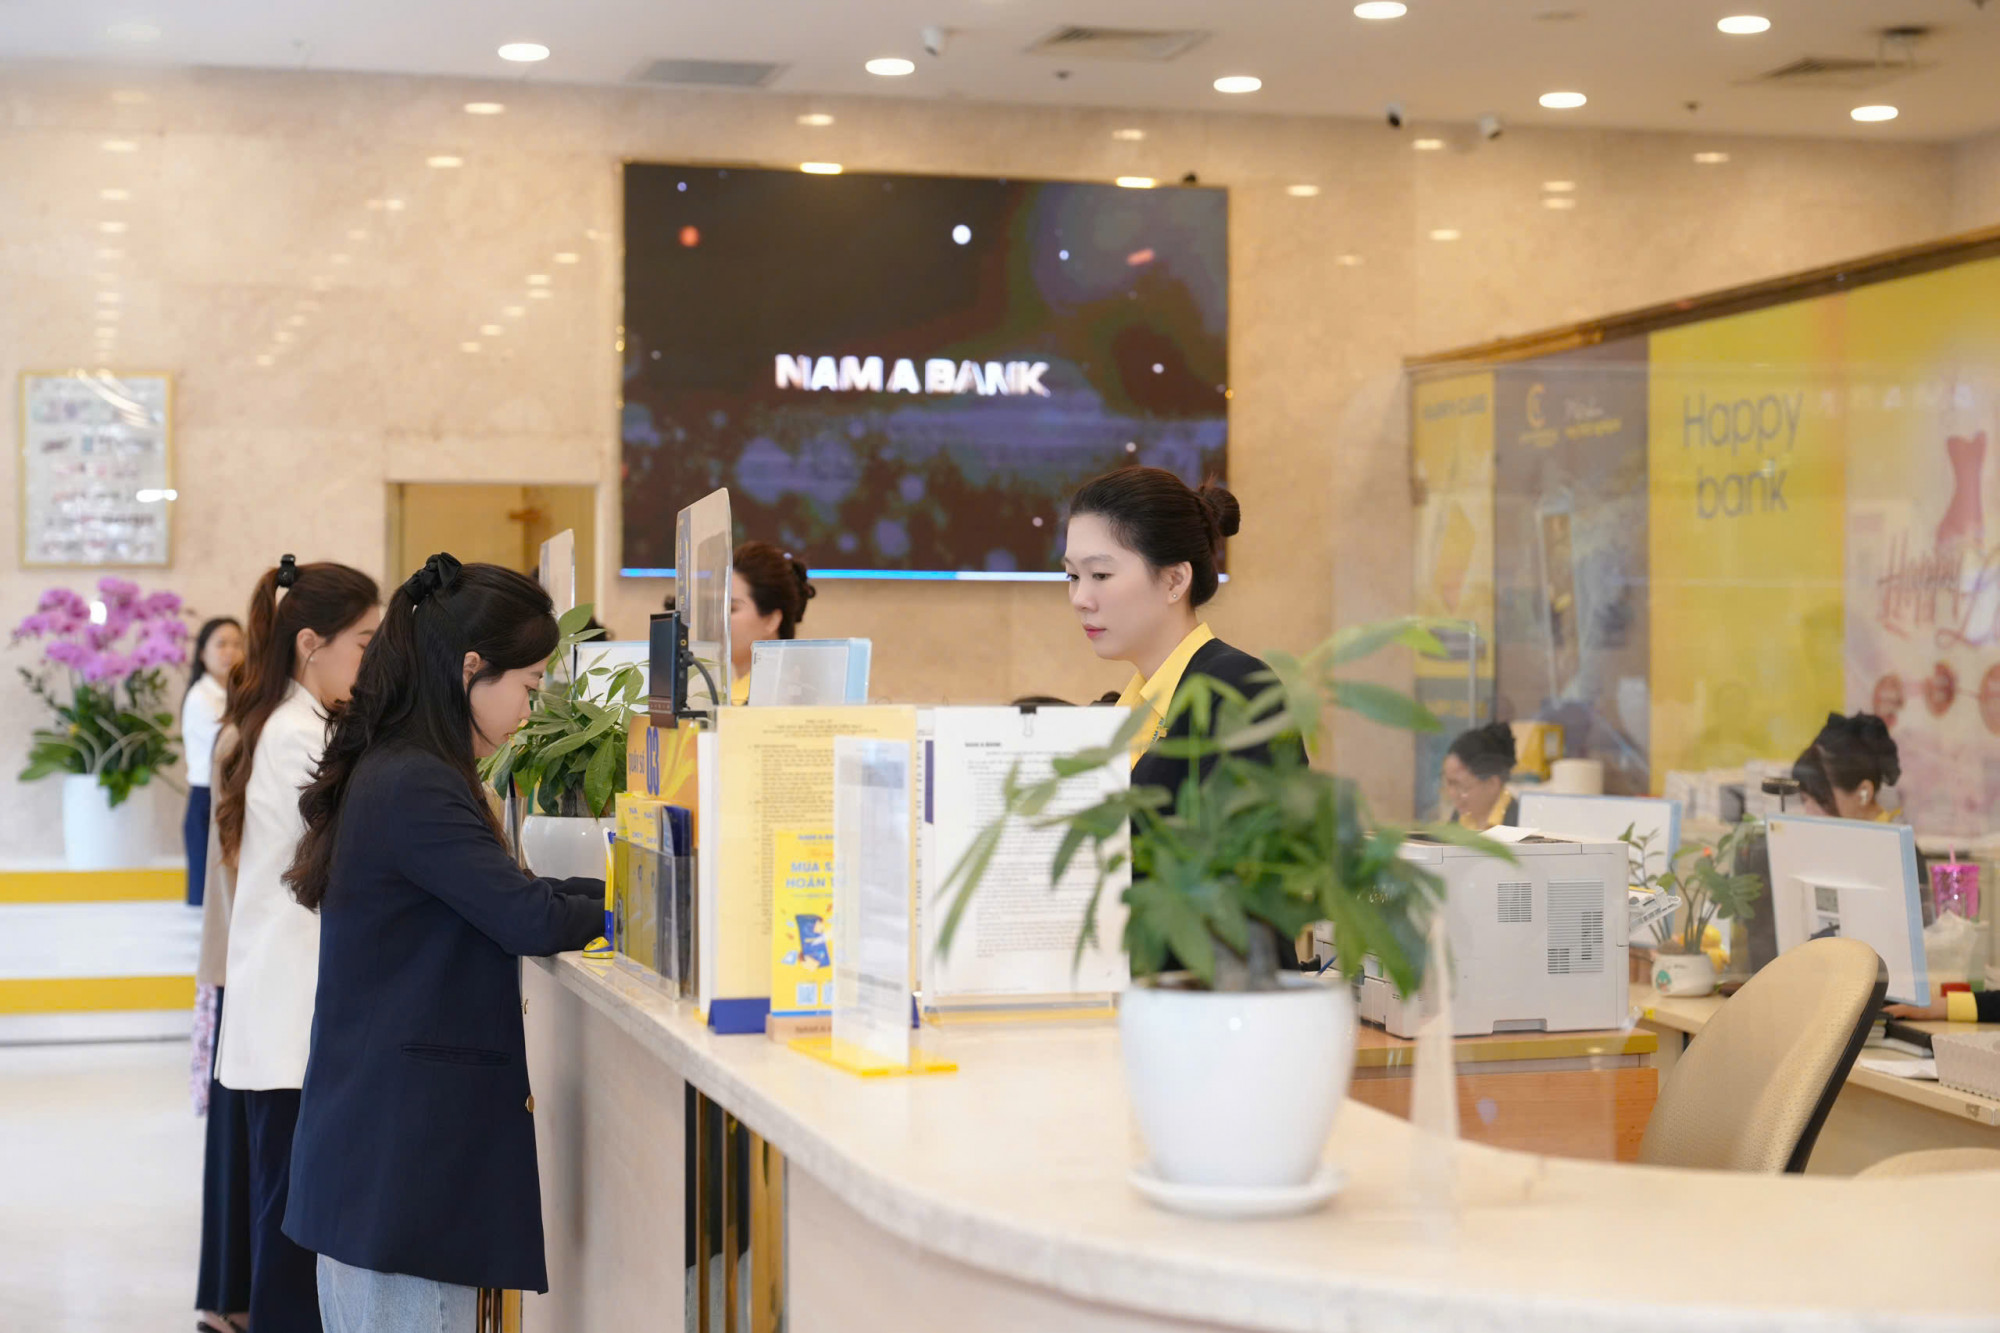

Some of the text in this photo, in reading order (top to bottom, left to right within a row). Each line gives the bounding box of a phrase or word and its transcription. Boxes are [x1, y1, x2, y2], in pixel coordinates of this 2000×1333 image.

[775, 354, 1051, 398] NAM A BANK
[1683, 391, 1804, 456] Happy
[1697, 458, 1788, 519] bank
[646, 726, 660, 796] 03
